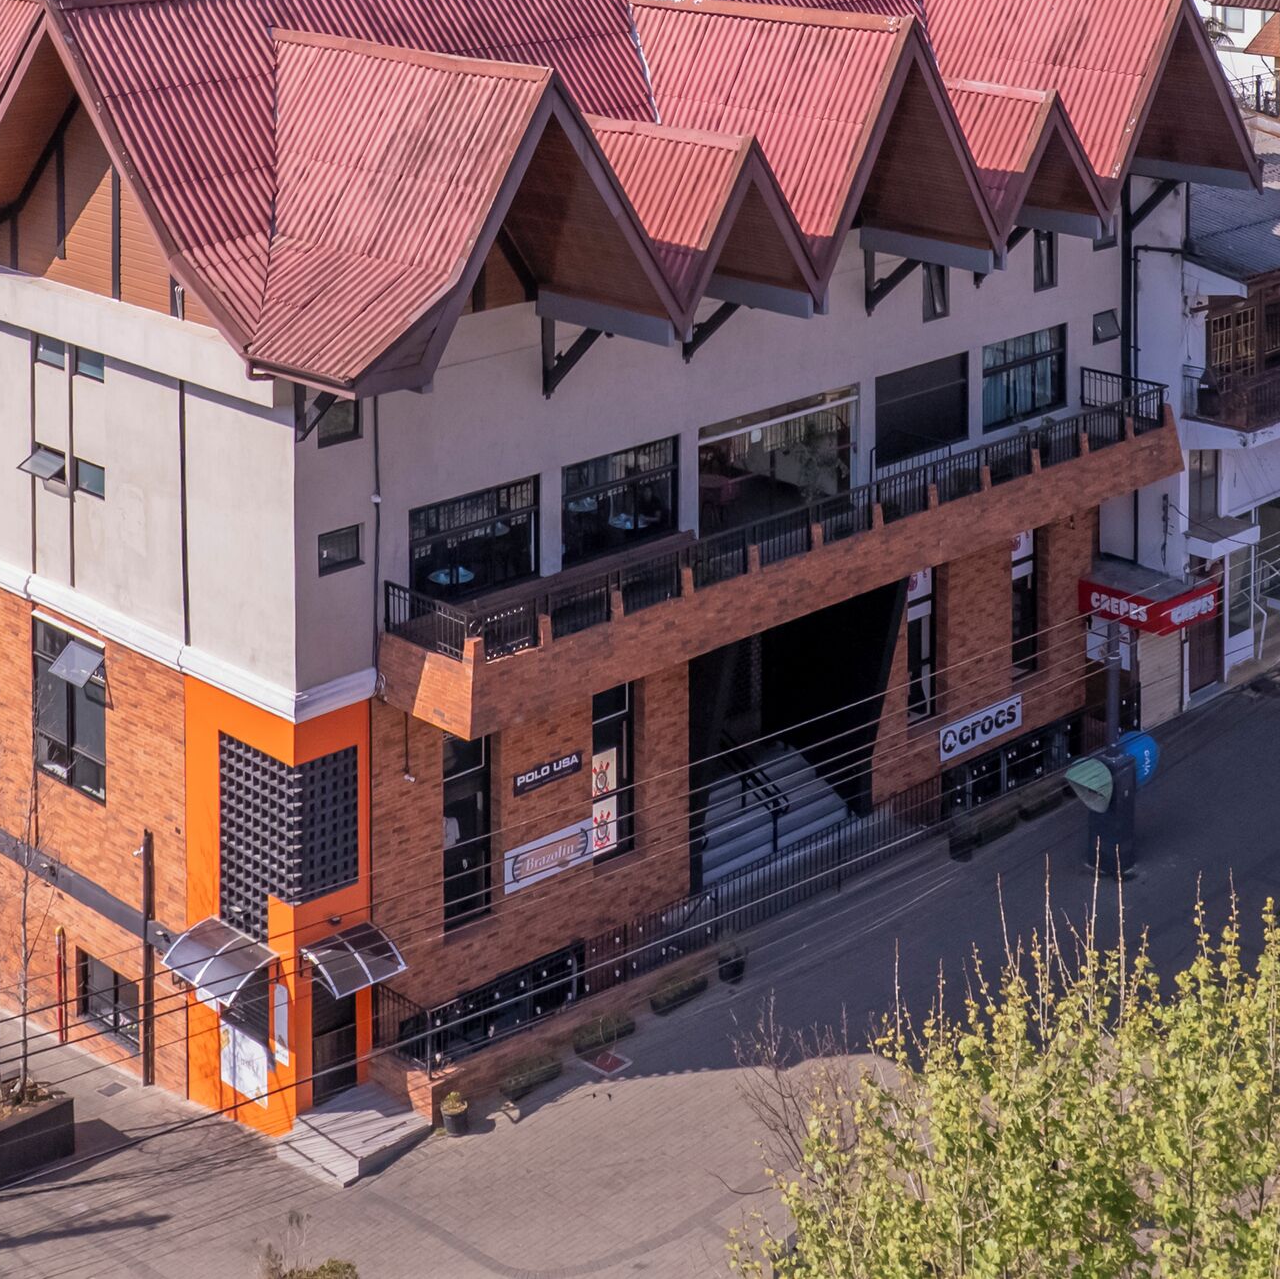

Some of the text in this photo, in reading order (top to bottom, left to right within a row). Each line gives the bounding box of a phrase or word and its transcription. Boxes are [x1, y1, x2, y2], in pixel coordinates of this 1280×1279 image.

[1090, 592, 1148, 622] CREPES
[959, 705, 1017, 745] crocs
[517, 765, 551, 787] POLO
[553, 754, 579, 771] USA
[525, 843, 575, 871] Brazolin
